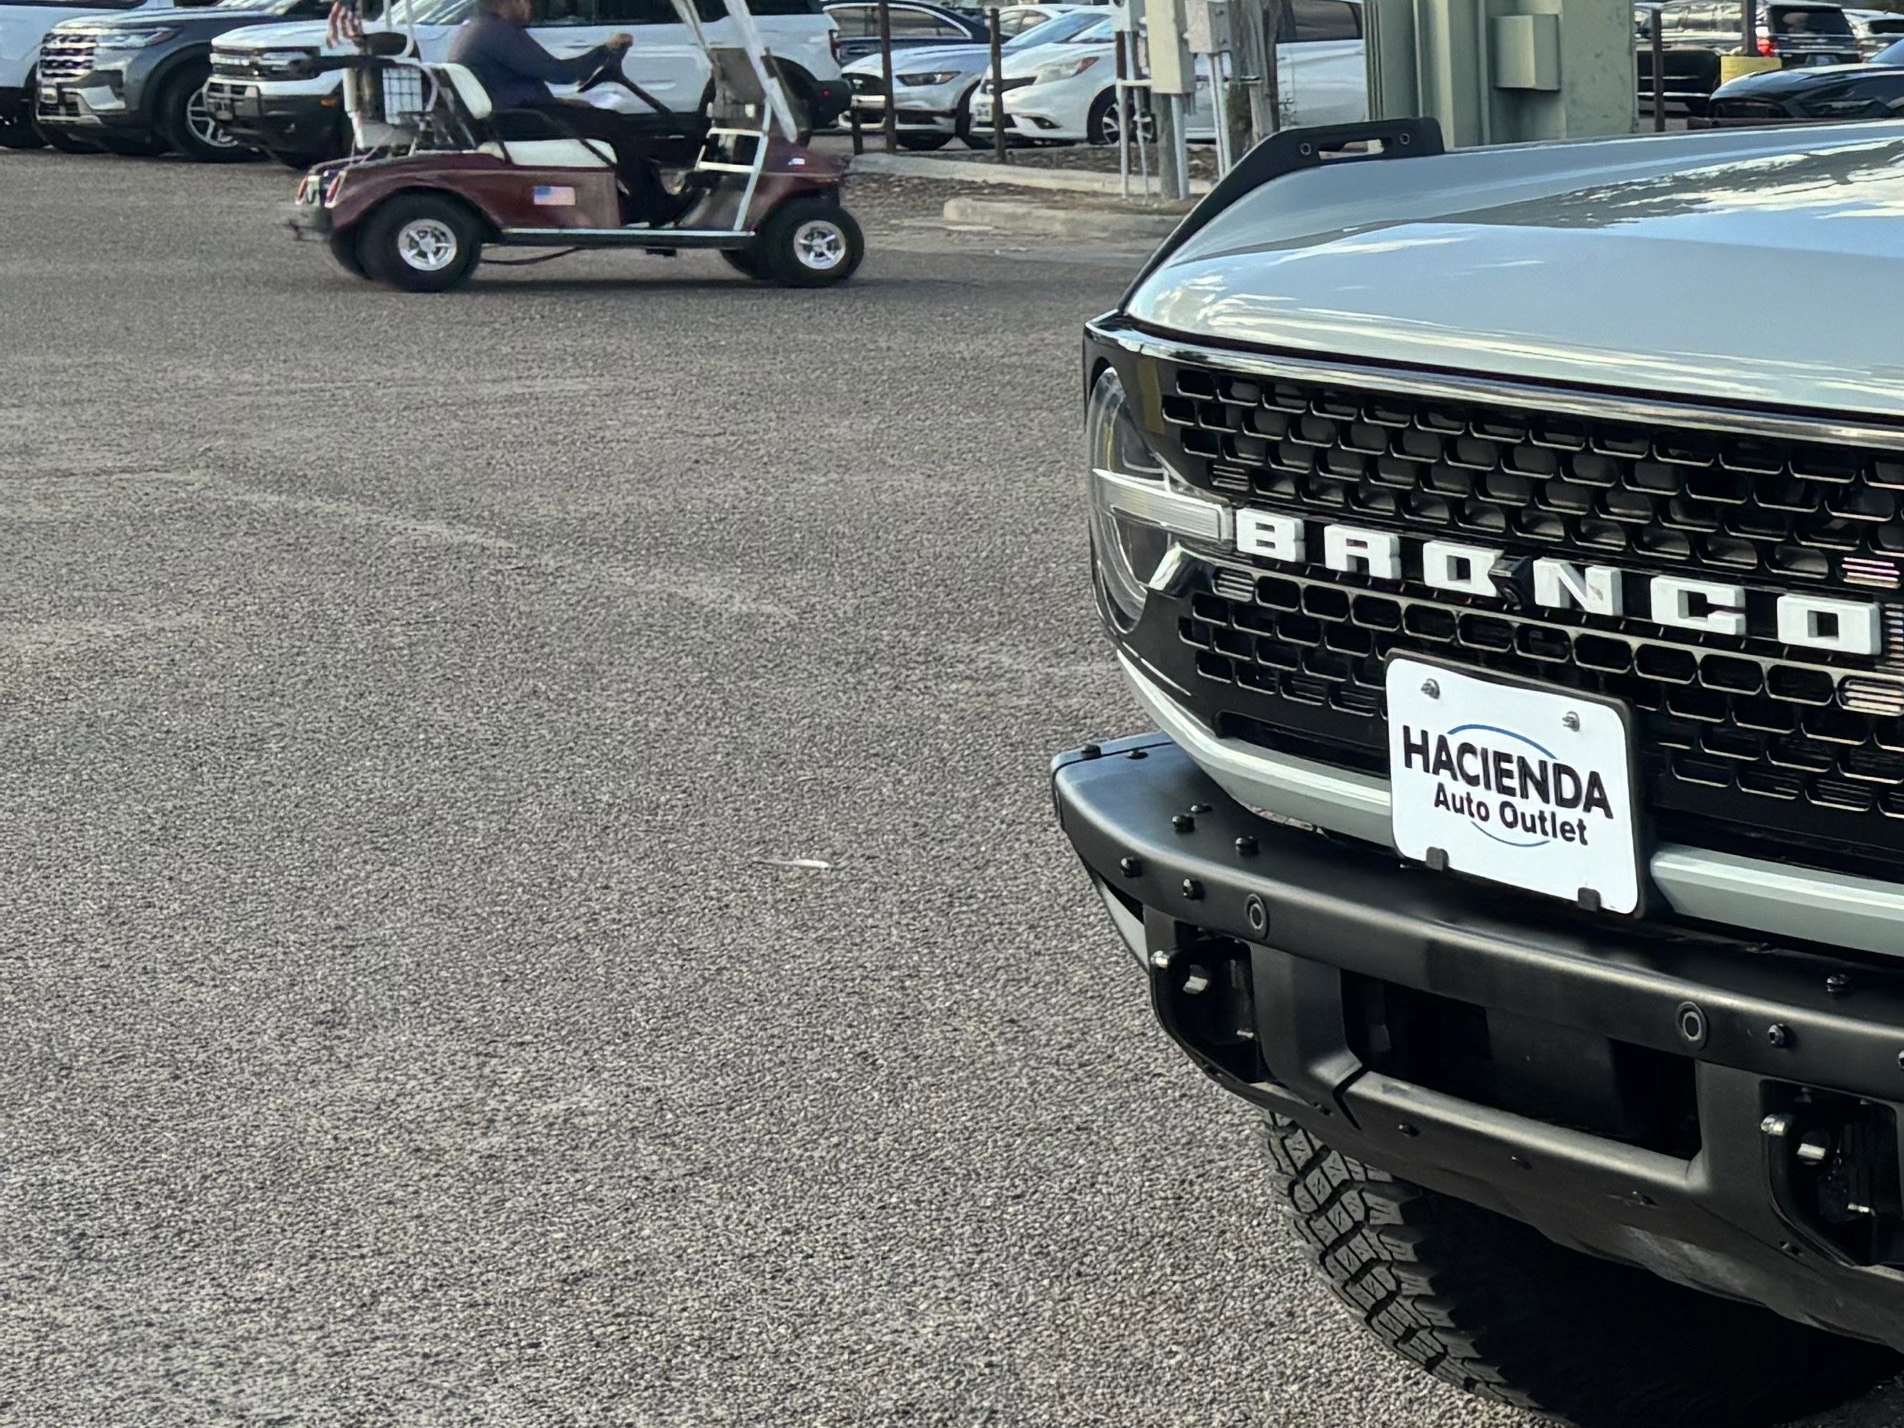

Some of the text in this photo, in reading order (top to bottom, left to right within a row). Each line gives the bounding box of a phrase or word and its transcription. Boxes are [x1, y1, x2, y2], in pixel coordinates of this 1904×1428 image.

[1236, 508, 1882, 655] BRONCO
[1402, 724, 1614, 820] HACIENDA
[1433, 782, 1589, 846] Auto Outlet
